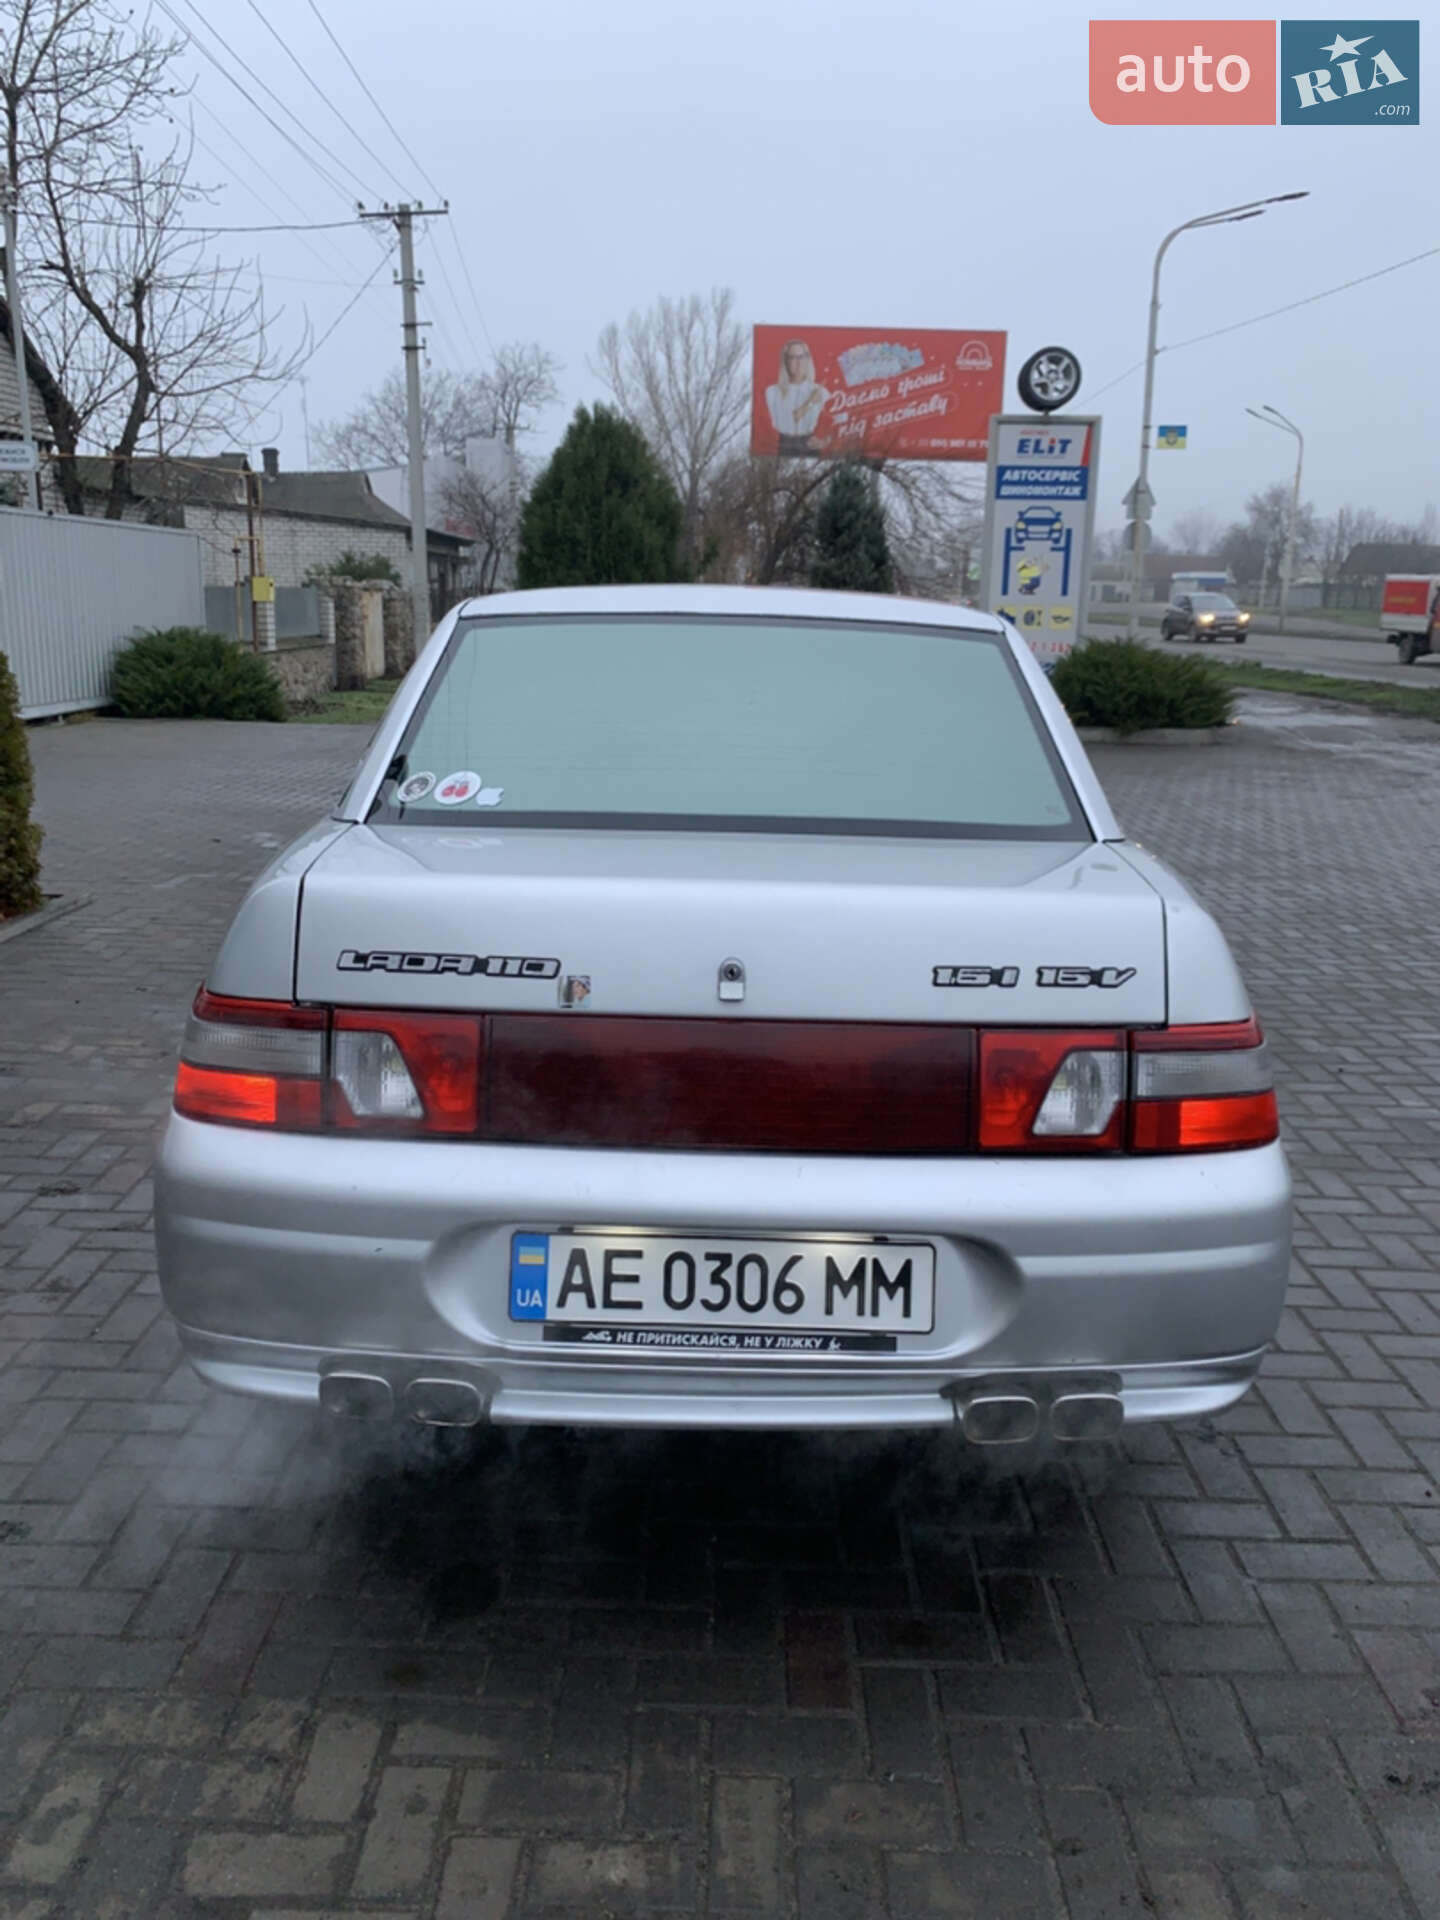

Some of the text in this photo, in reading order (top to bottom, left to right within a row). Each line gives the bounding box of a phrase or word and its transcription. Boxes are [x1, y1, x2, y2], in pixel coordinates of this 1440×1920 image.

[1002, 469, 1081, 482] АВТОСЕРВІС
[999, 485, 1083, 497] ШИНОМОНТАЖ
[336, 950, 562, 980] LADA 110
[556, 1247, 912, 1319] AE 0306 MM
[515, 1288, 543, 1309] UA
[616, 1331, 822, 1350] НЕ ПРИТИСКАЙСЯ, НЕ У ЛІЖКУ
